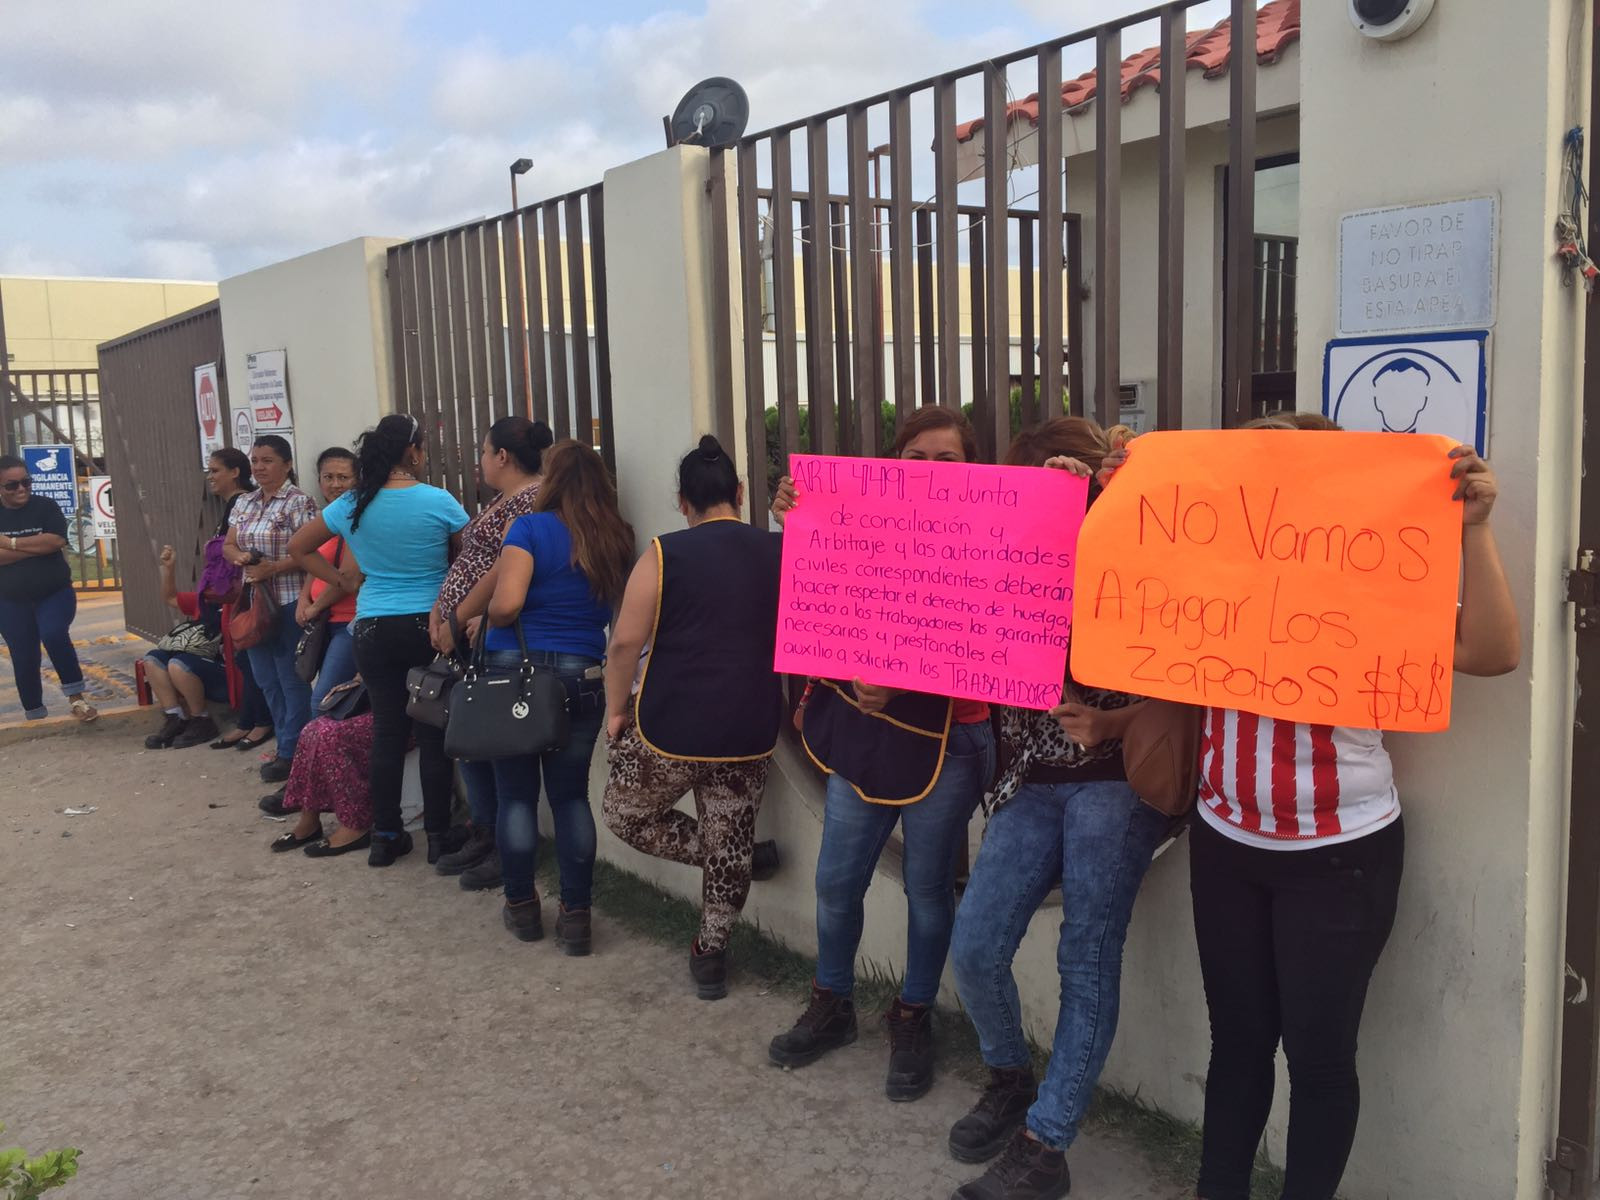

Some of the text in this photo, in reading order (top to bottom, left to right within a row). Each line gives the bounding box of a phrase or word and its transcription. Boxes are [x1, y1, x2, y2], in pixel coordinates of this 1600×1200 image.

[1370, 212, 1465, 240] FAVOR DE
[1371, 247, 1401, 266] NO
[1365, 299, 1406, 320] ESTA
[200, 391, 217, 421] ALTO
[31, 482, 73, 491] ERMANENTE
[793, 459, 841, 494] ART
[927, 469, 950, 502] La
[958, 469, 1018, 508] Junta
[830, 503, 1004, 544] de conciliación y
[809, 529, 1070, 569] Arbitraje y las autoridades
[792, 573, 840, 596] hacer
[845, 584, 902, 603] respetar
[905, 589, 917, 604] el
[922, 592, 980, 614] derecho
[984, 600, 1005, 617] de
[855, 564, 988, 590] correspondientes
[994, 572, 1073, 602] deberán
[789, 596, 836, 615] dando
[839, 605, 849, 616] a
[875, 606, 963, 632] trabajadores
[1094, 568, 1358, 651] A Pagar Los
[783, 639, 833, 660] auxilio
[853, 649, 909, 673] soliciten
[919, 657, 940, 679] los
[784, 617, 1009, 666] necesarias y prestandoles el
